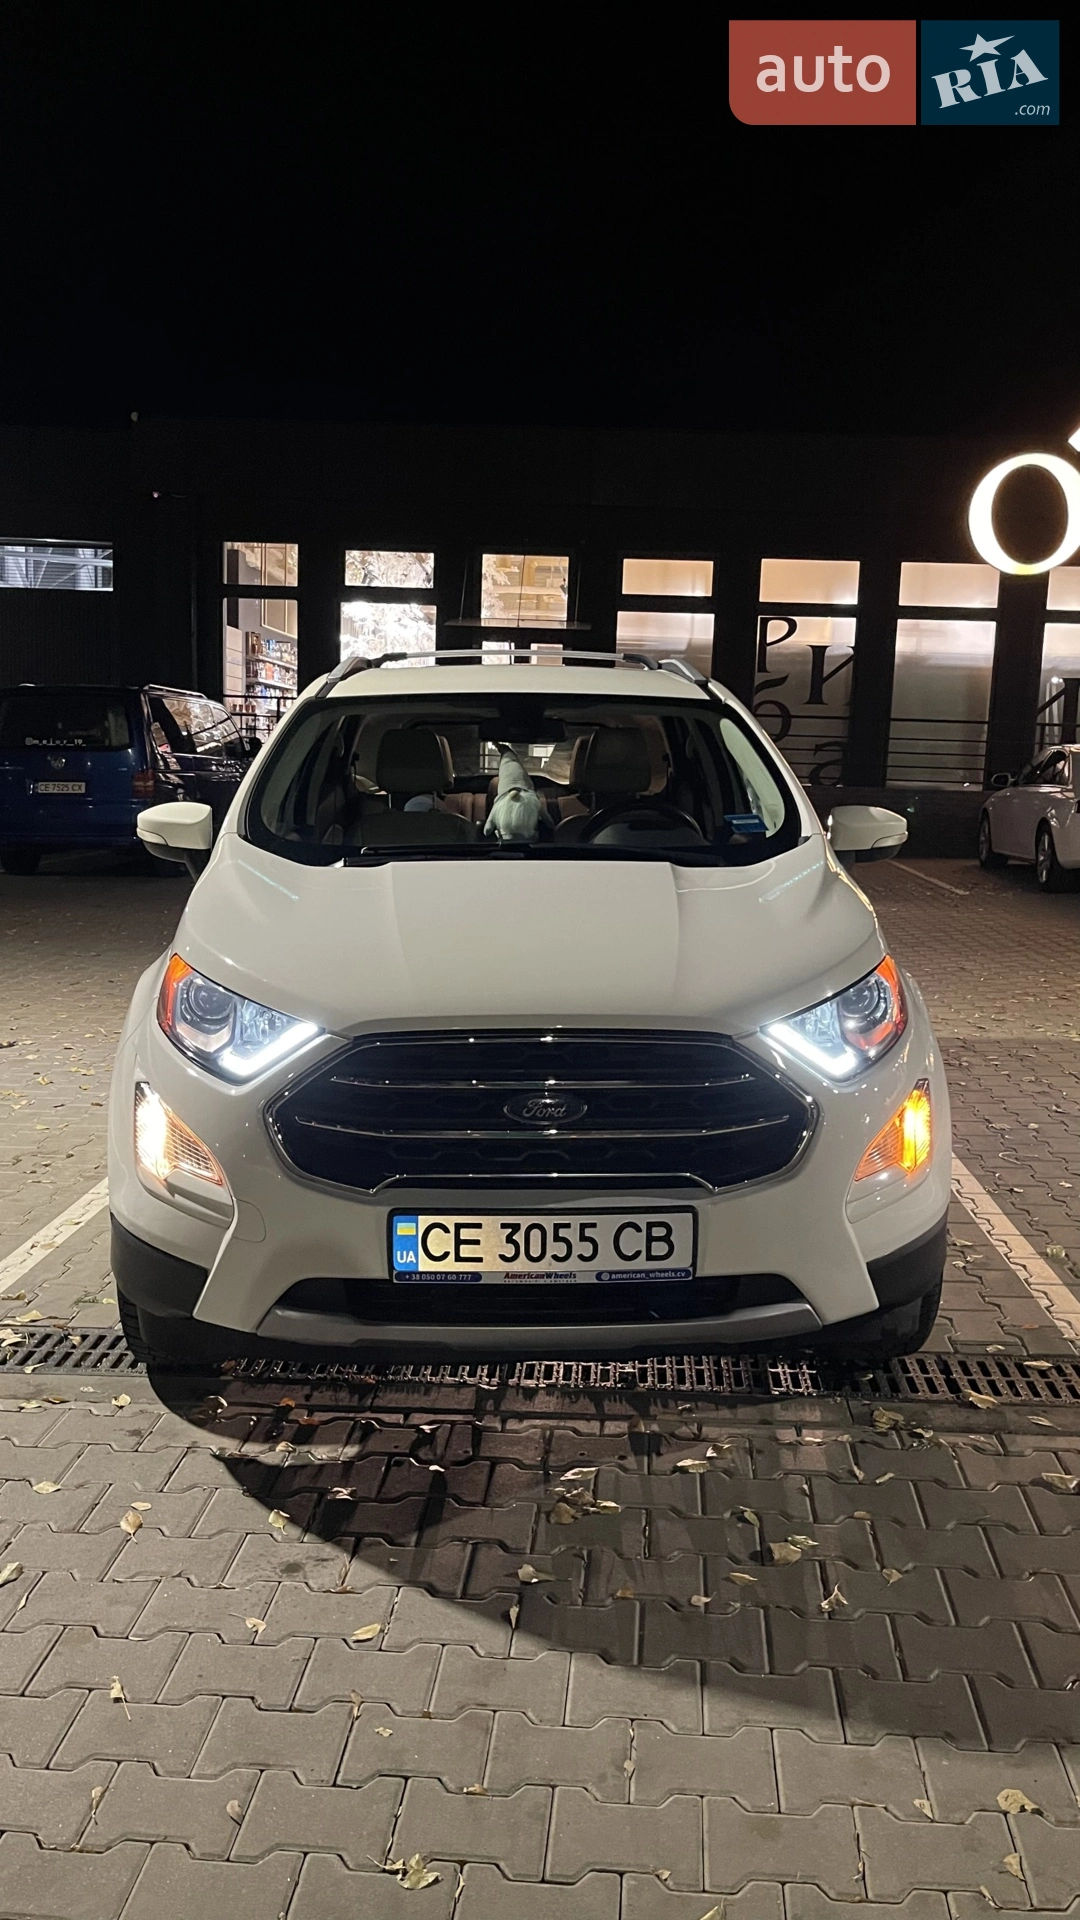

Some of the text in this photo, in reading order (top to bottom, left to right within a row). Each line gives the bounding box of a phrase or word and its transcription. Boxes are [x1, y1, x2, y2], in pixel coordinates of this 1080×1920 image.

[39, 784, 83, 792] CE 7525 CX
[522, 1099, 568, 1117] Ford
[420, 1221, 675, 1263] CE 3055 CB
[396, 1250, 417, 1264] UA
